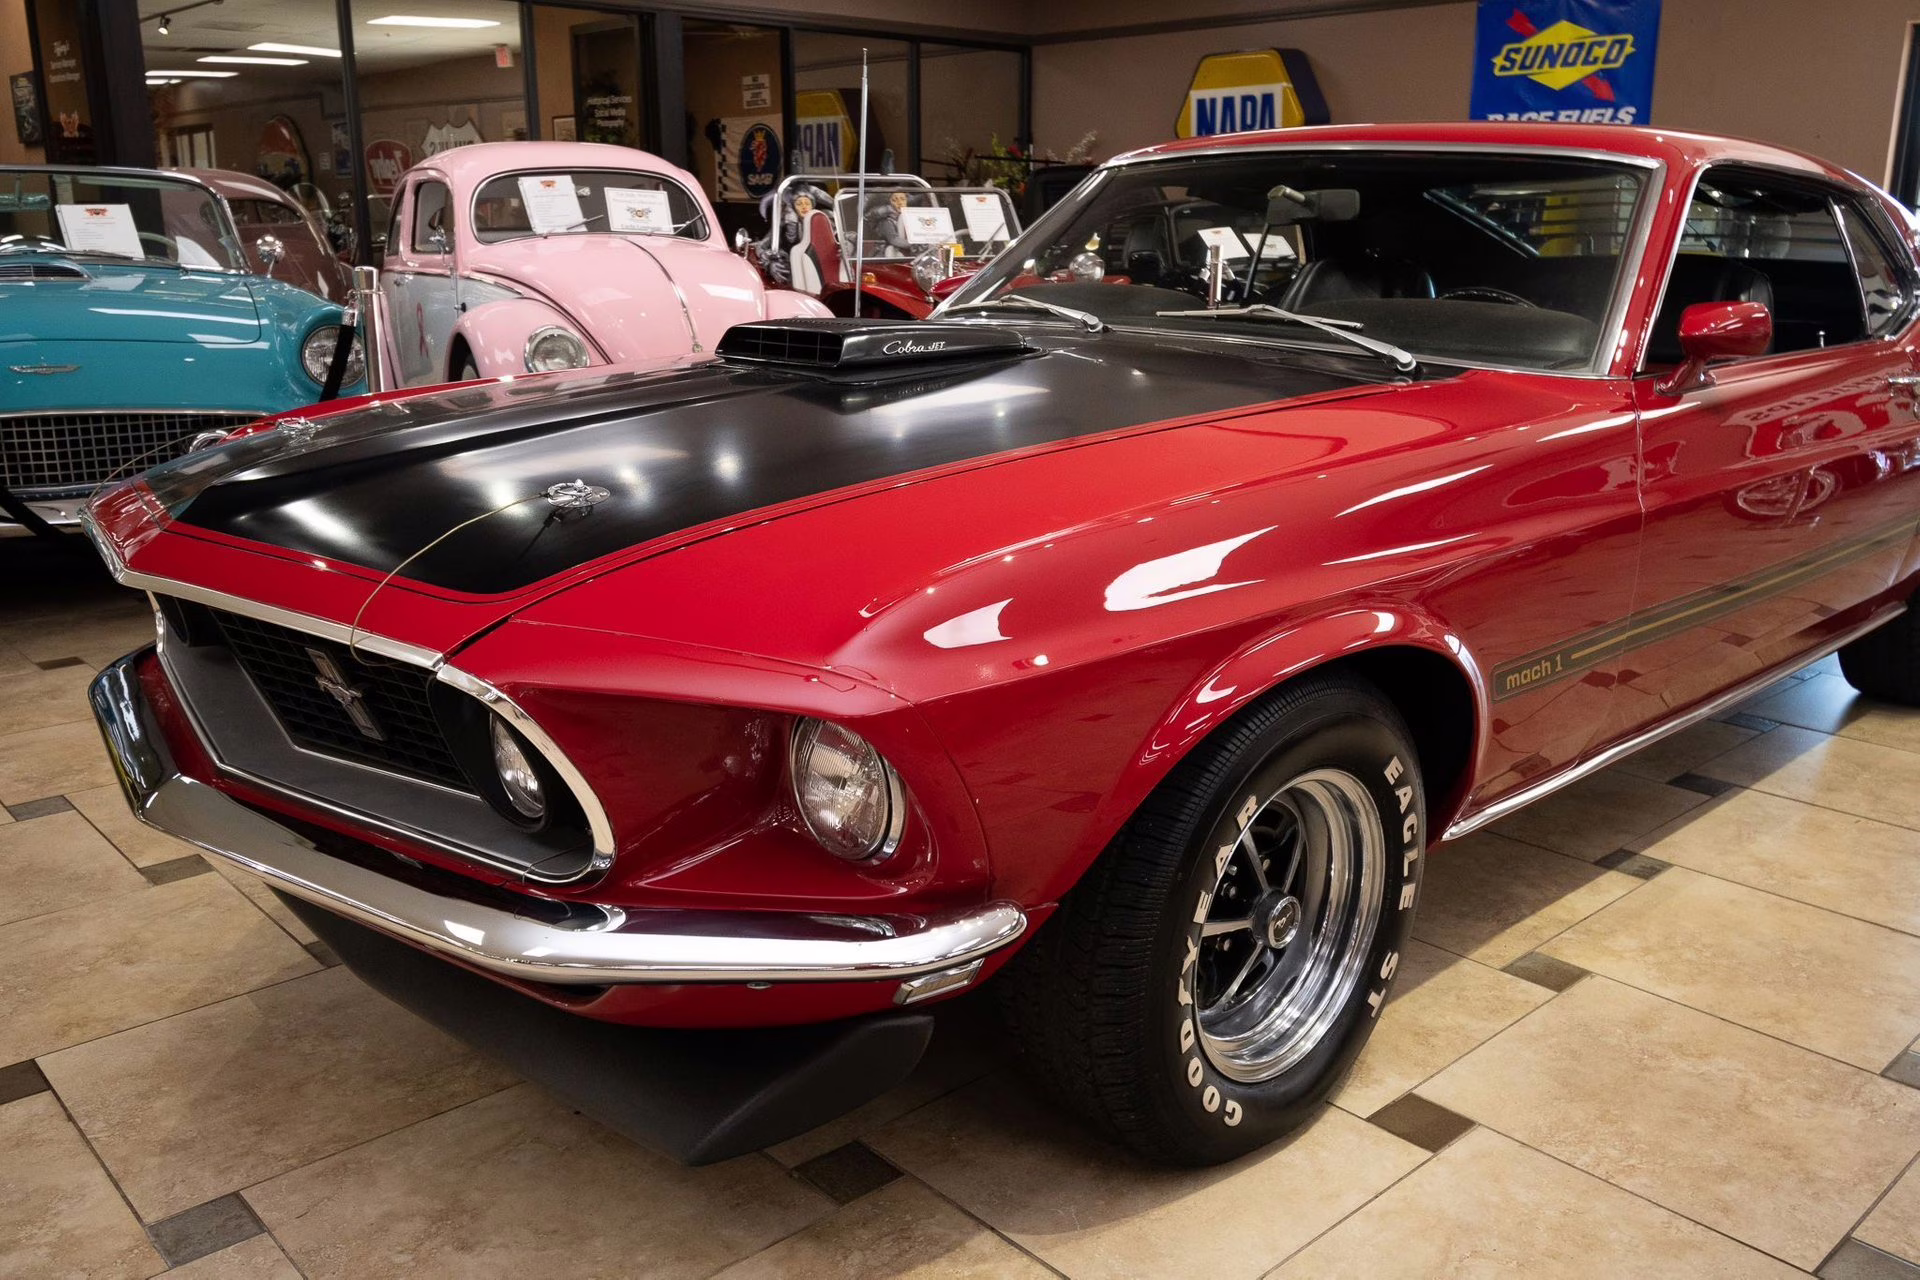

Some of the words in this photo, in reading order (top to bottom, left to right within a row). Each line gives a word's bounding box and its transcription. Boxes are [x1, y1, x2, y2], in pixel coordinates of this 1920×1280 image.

[1498, 38, 1629, 73] SUNOCO
[1196, 93, 1276, 137] NAPA
[883, 340, 925, 355] Cobra
[928, 341, 946, 351] JET
[1506, 659, 1551, 690] mach
[1555, 654, 1563, 672] 1
[1384, 755, 1419, 912] EAGLE
[1178, 795, 1258, 1127] GOODYEAR
[1367, 951, 1399, 1018] ST
